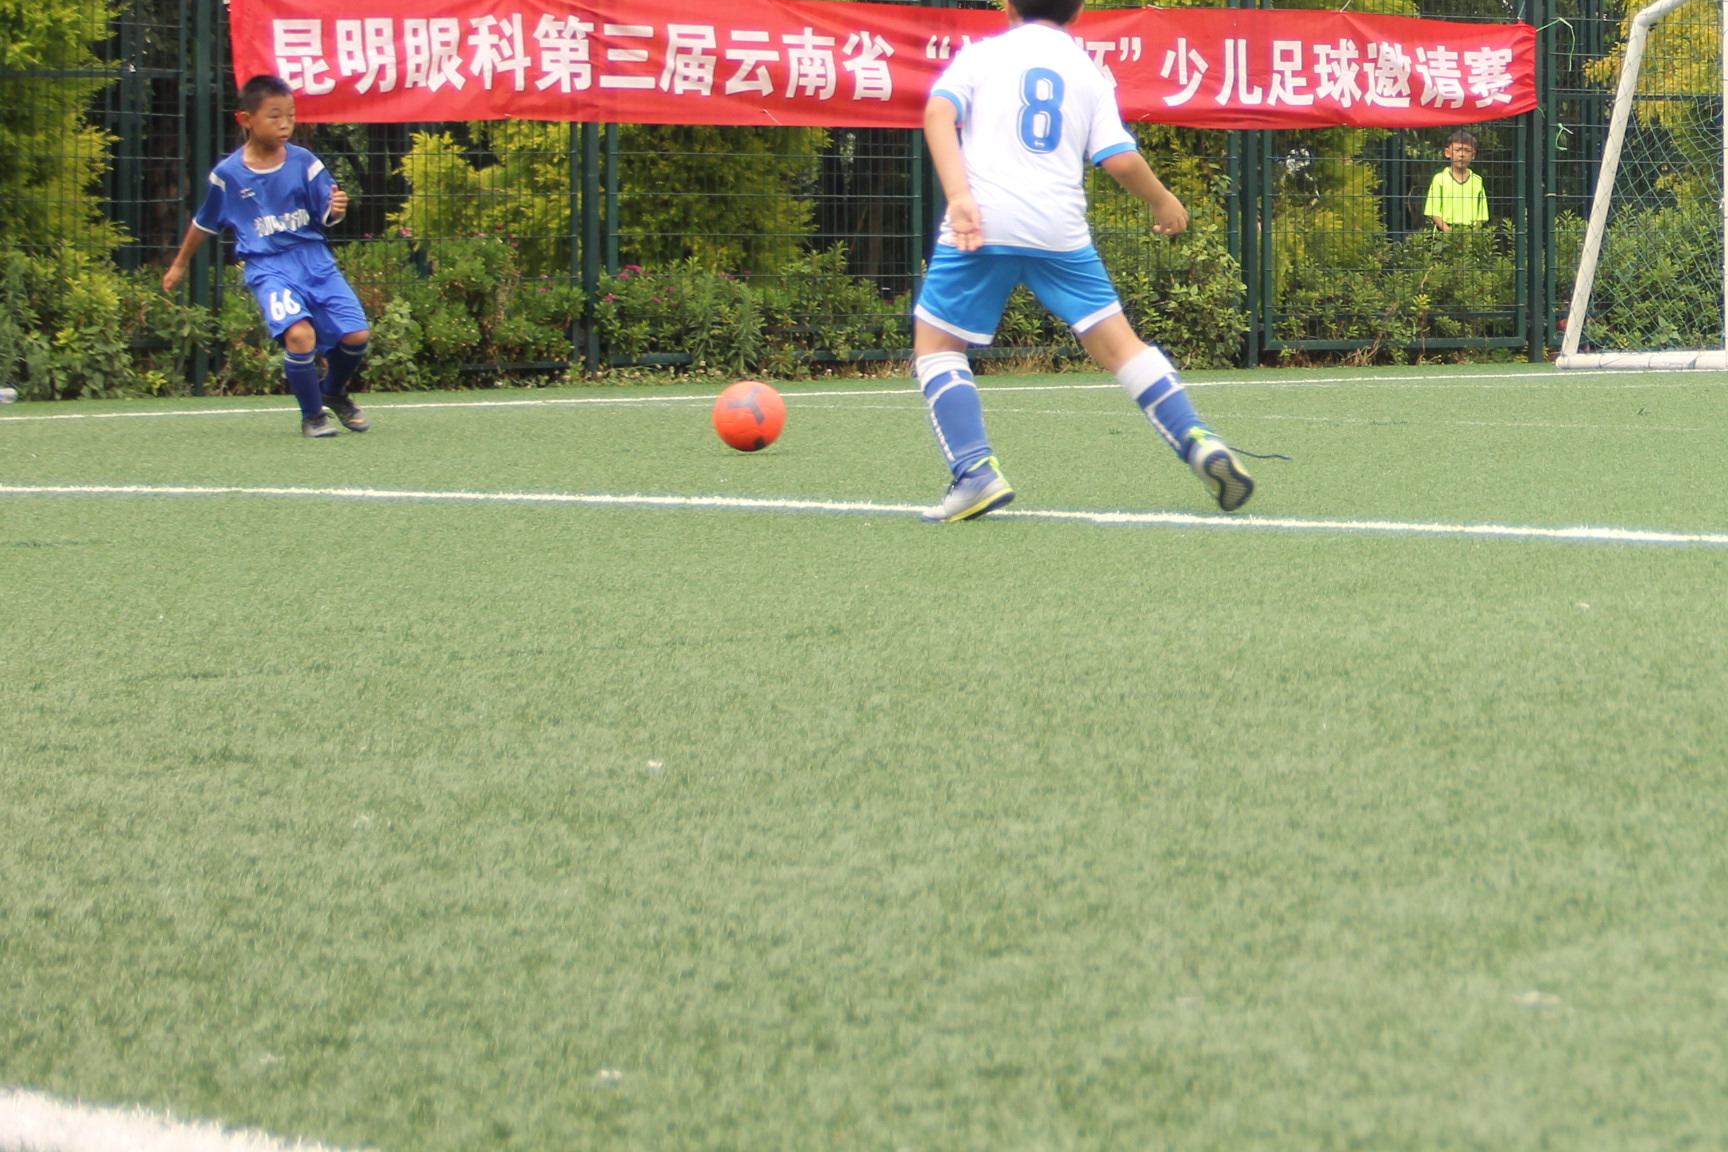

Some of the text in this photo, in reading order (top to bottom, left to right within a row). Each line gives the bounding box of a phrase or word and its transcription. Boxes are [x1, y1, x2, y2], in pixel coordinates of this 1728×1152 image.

[273, 13, 1513, 109] 昆明眼科第三届云南省“”少儿足球邀请赛
[1017, 67, 1065, 154] 8
[269, 288, 302, 322] 66
